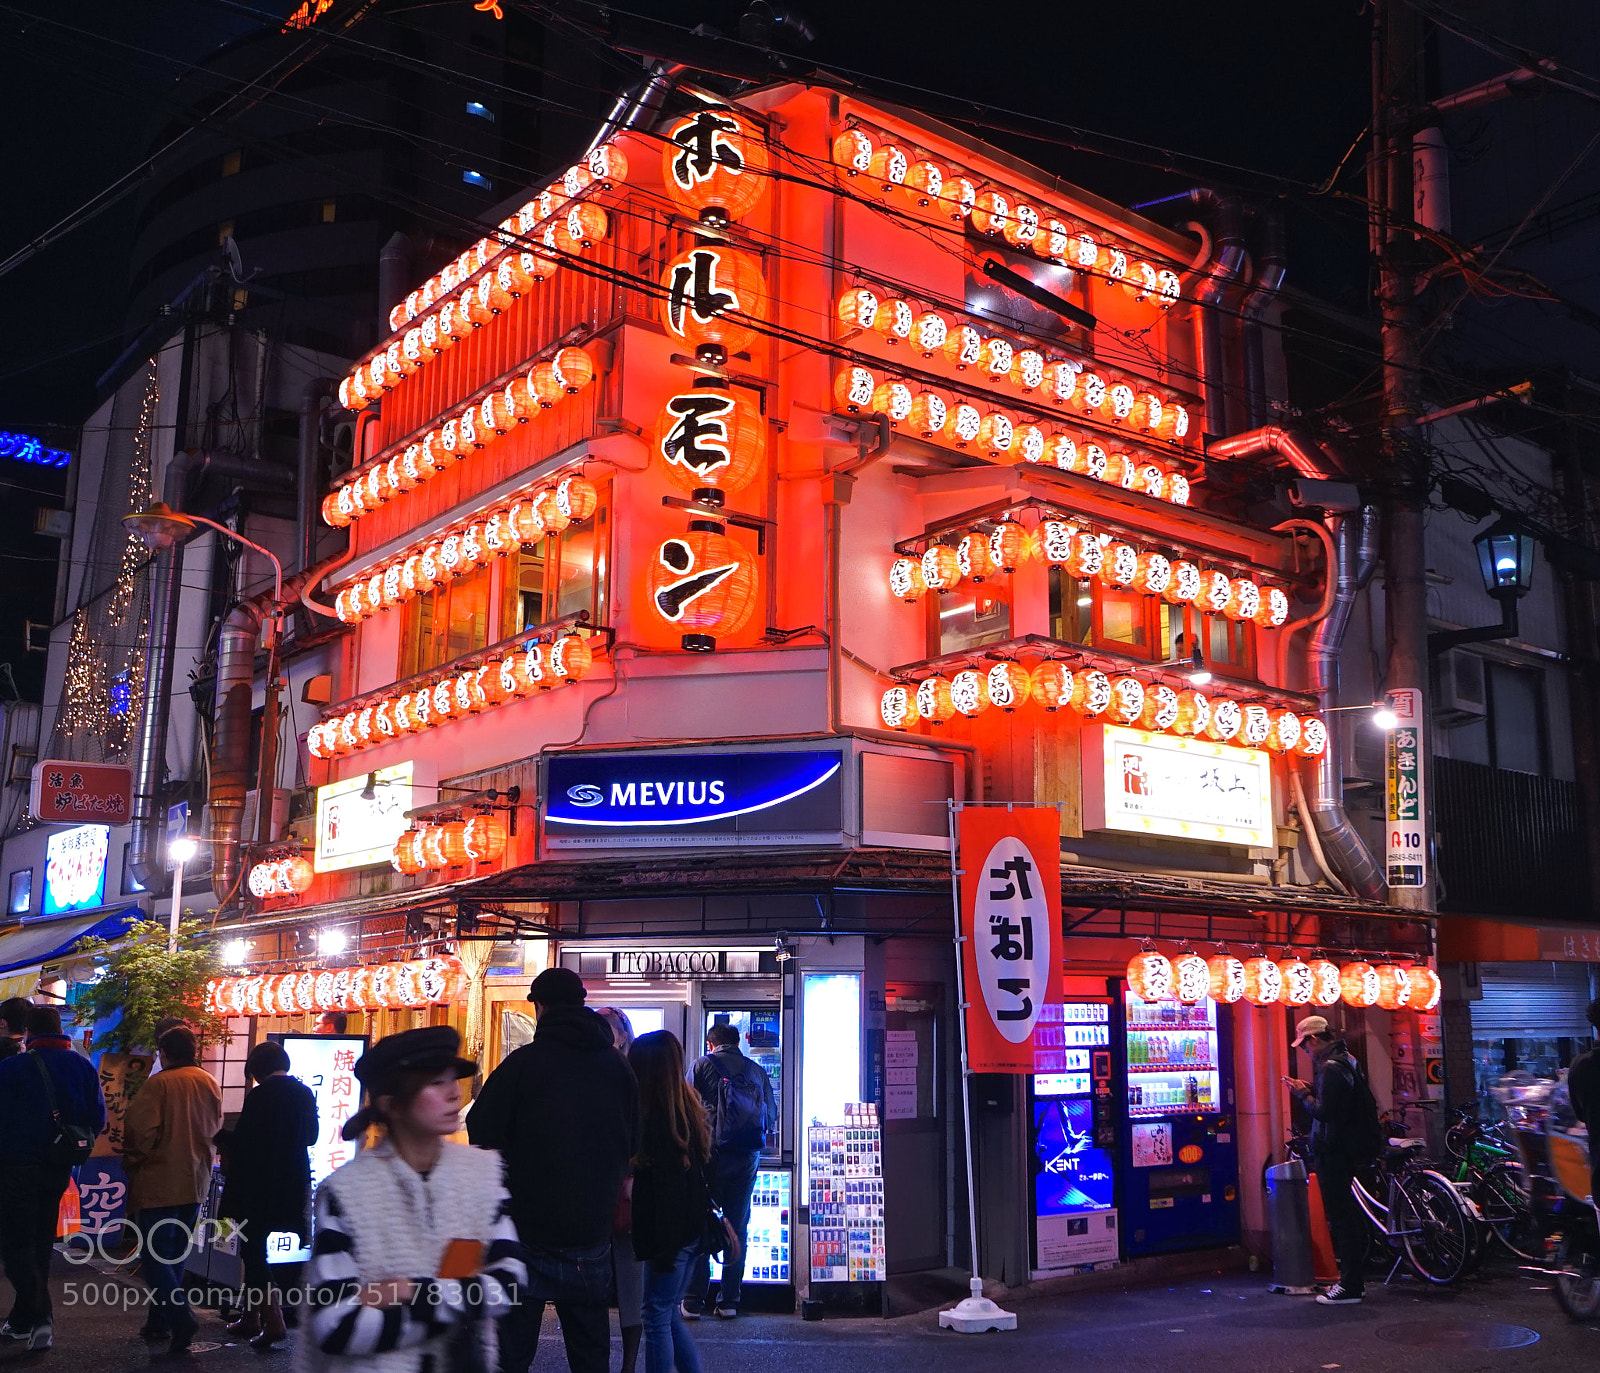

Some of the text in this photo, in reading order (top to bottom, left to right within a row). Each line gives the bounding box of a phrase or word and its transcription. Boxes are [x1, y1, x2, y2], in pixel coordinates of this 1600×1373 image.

[655, 112, 744, 620] ホルモン
[48, 772, 84, 790] 活魚
[1396, 730, 1418, 817] あきんど
[54, 792, 125, 814] 炉ばた焼
[611, 781, 725, 806] MEVIUS
[1404, 833, 1421, 849] 10
[623, 952, 716, 973] TOBACCO
[1045, 1157, 1080, 1174] KENT
[79, 1172, 126, 1235] 空
[277, 1236, 292, 1252] 円
